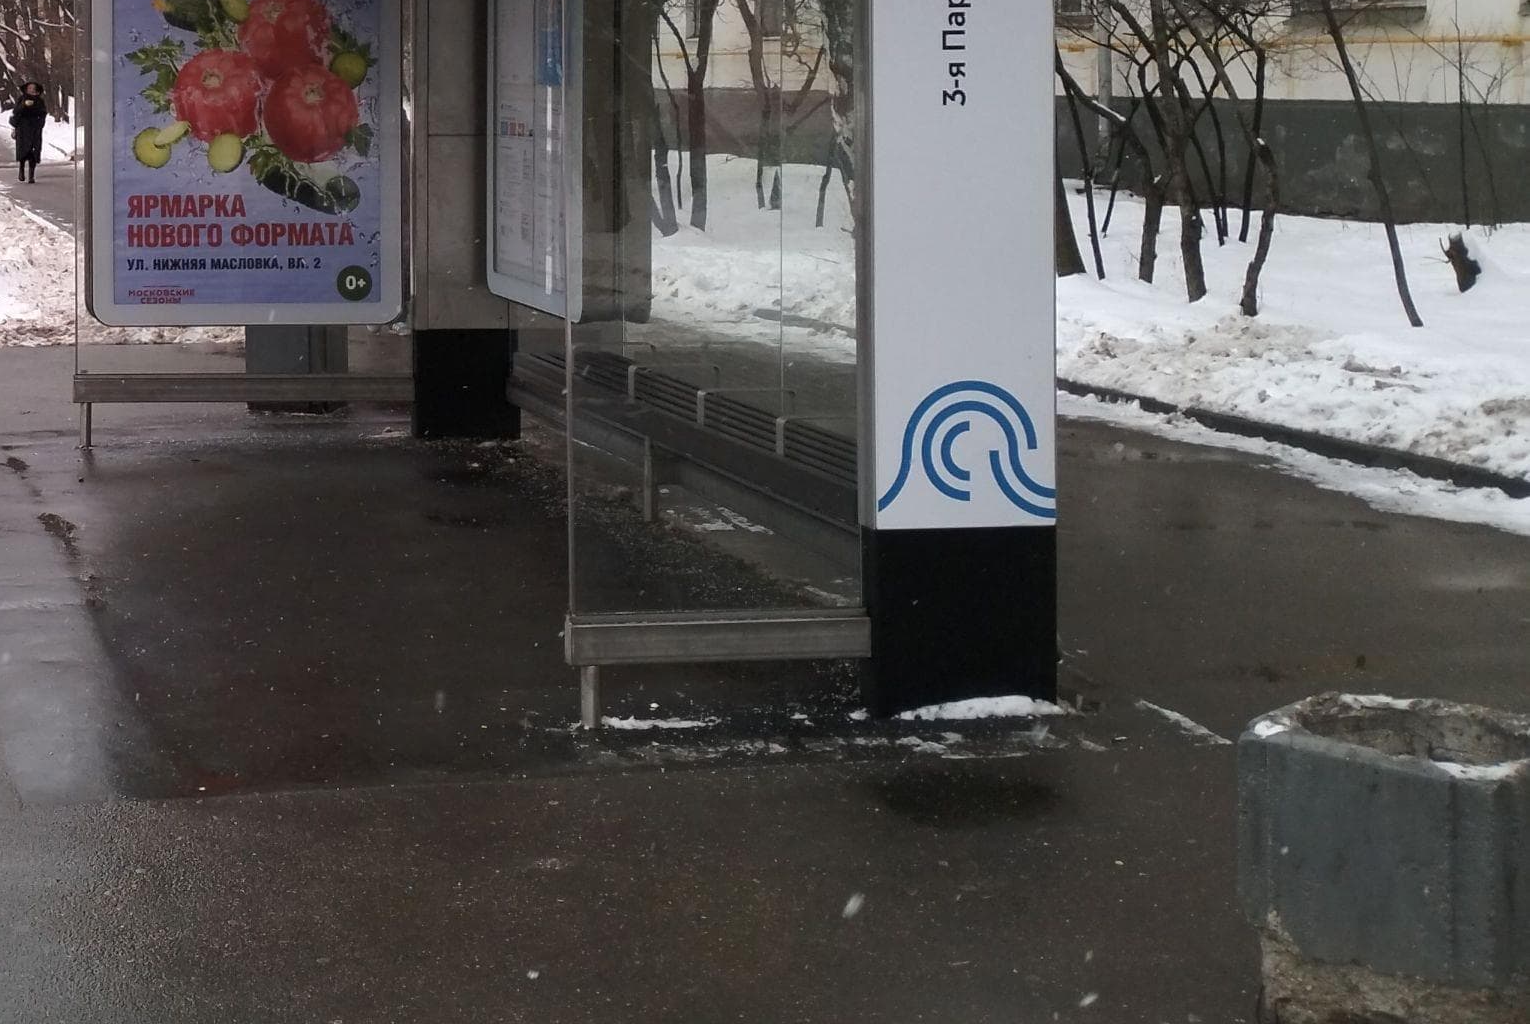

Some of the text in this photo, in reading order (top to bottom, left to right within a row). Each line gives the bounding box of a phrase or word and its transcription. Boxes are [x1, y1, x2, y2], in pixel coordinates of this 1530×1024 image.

[942, 62, 967, 106] 3-я
[127, 194, 247, 218] ЯРМАРКА
[127, 222, 355, 248] НОВОГО ФОРМАТА
[127, 257, 322, 271] УЛ. НИЖНЯЯ МАСЛОВКА, ВЛ. 2
[345, 275, 366, 290] 0+
[128, 288, 196, 297] МОСКОВСКИЕ
[140, 296, 182, 305] СЕЗОНЫ
